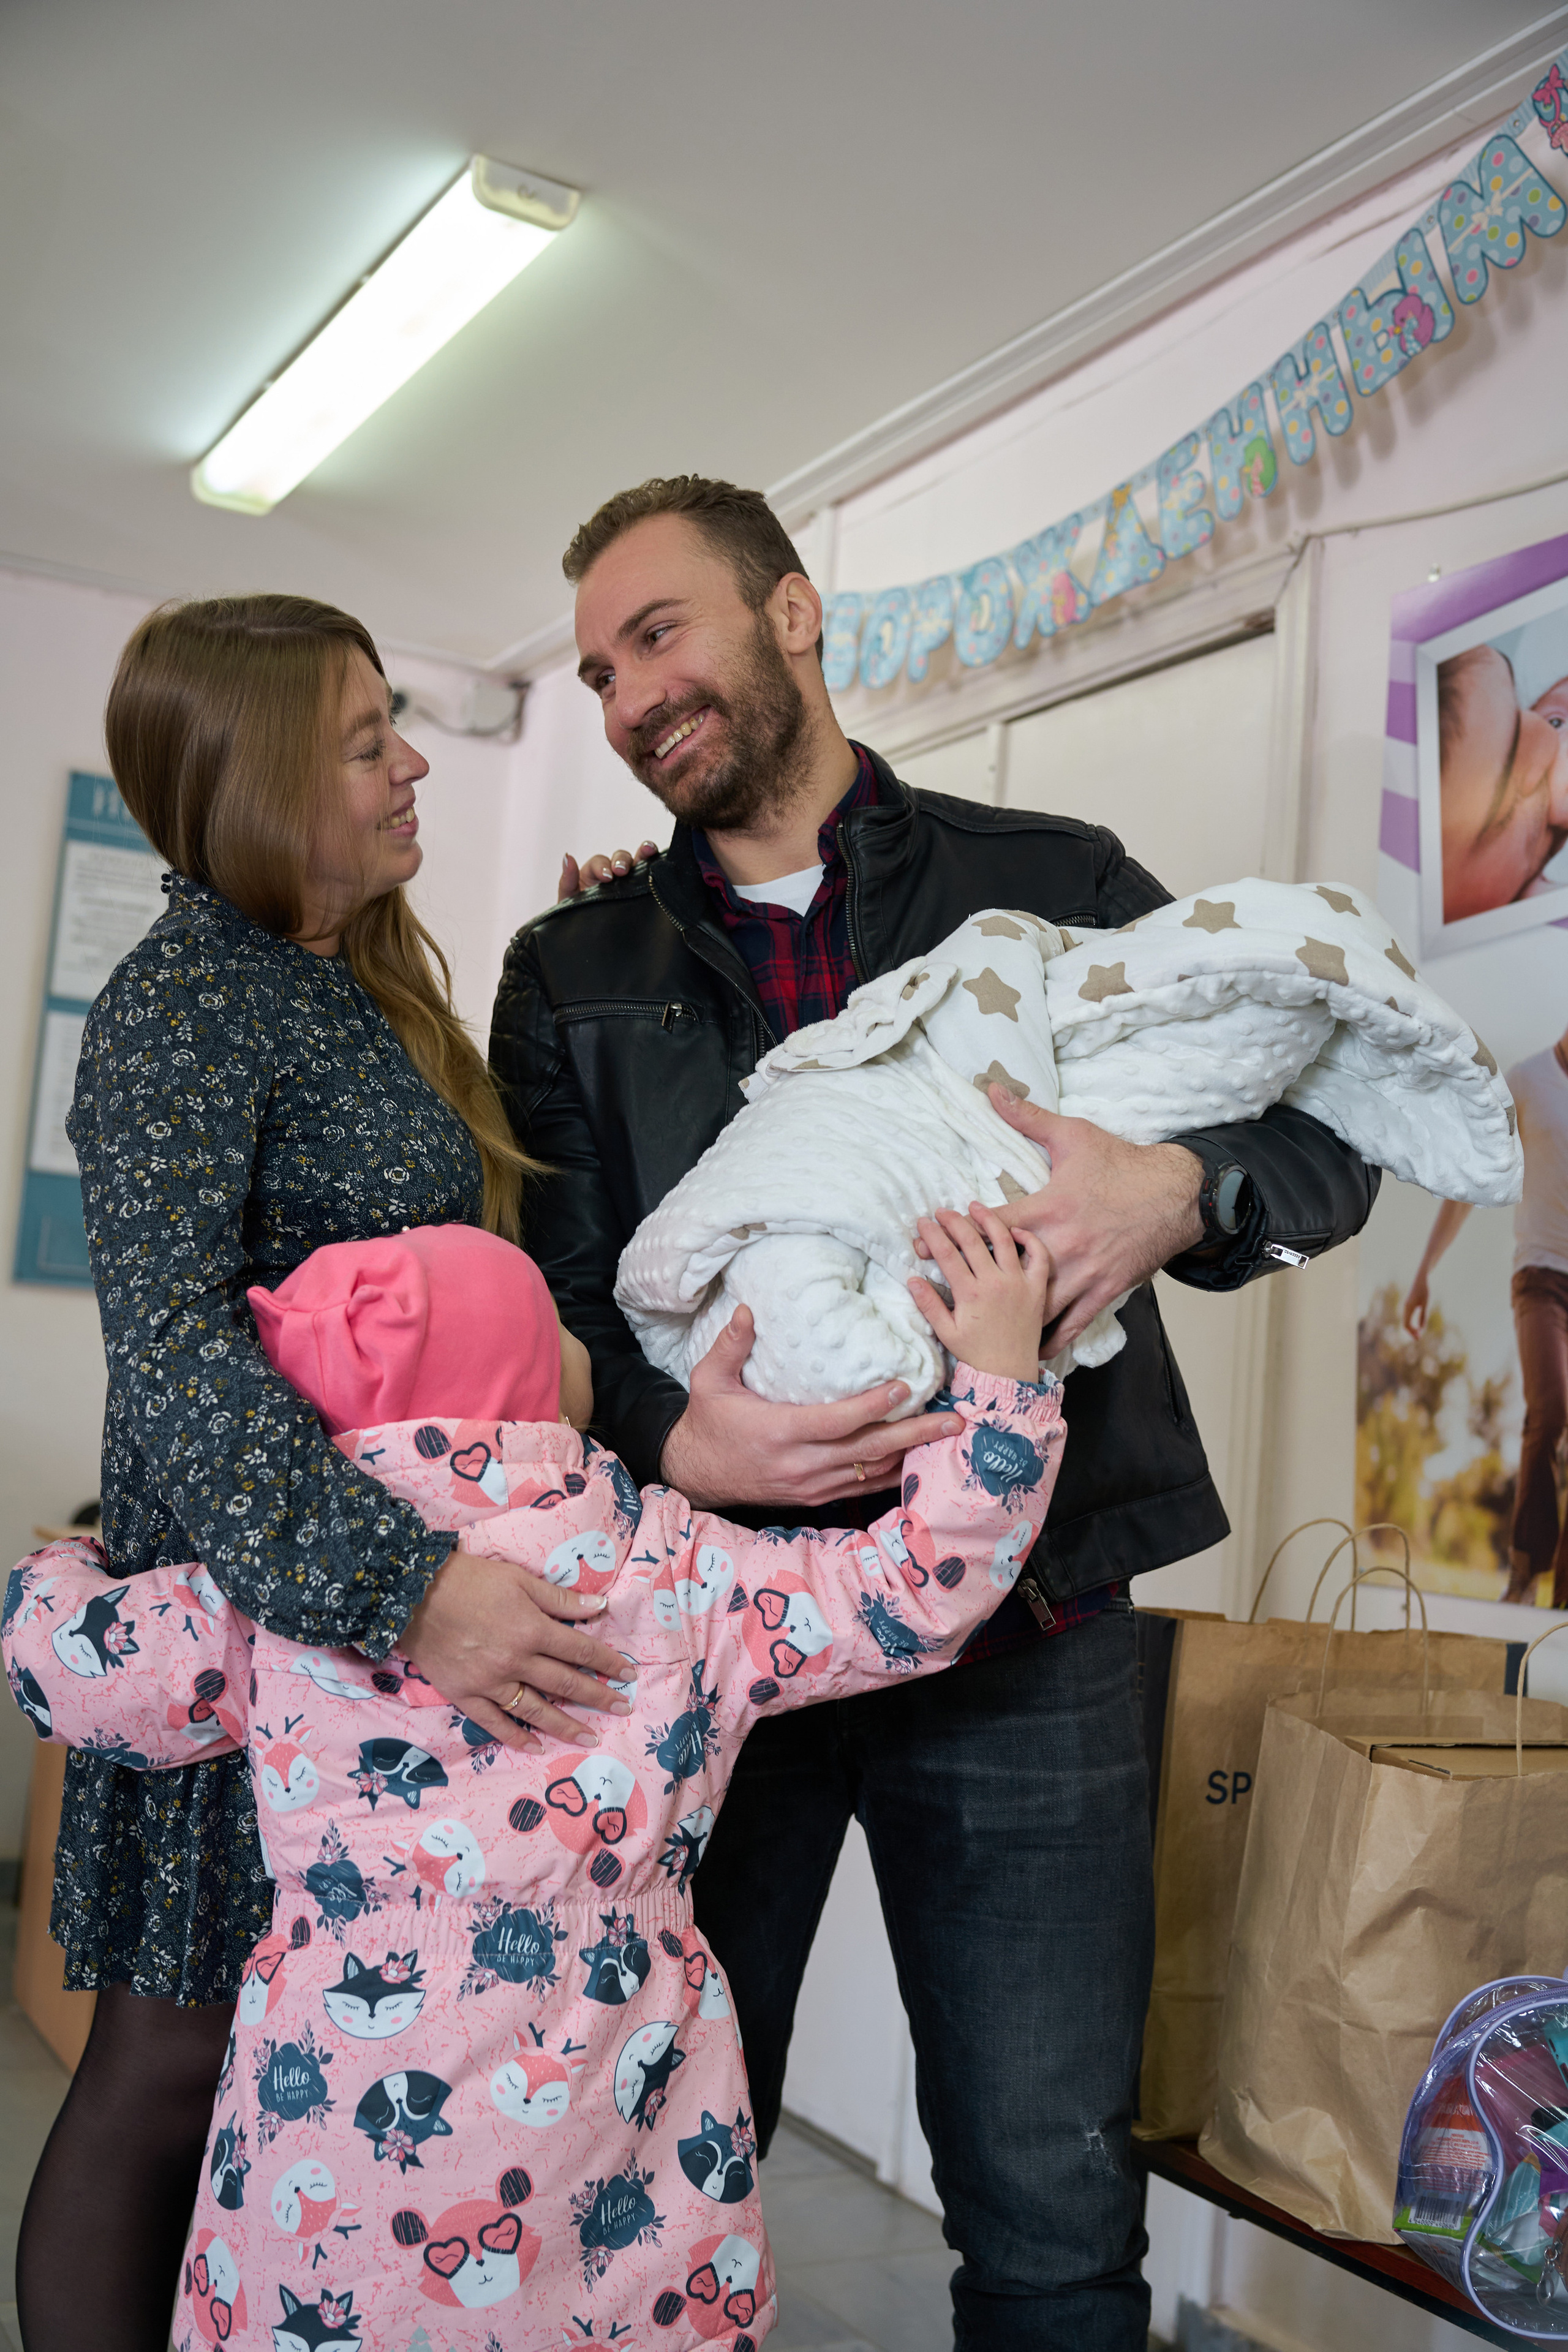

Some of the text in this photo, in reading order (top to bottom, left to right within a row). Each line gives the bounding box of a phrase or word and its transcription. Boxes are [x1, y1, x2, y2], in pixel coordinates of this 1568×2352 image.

[993, 1441, 1017, 1461] HAPPY
[983, 1451, 1023, 1483] Hello
[878, 1620, 899, 1641] HAPPY
[497, 1926, 540, 1954] Hello
[510, 1954, 535, 1967] HAPPY
[273, 2065, 311, 2093] Hello
[276, 2089, 309, 2103] BE HAPPY
[600, 2195, 637, 2226] Hello
[603, 2212, 635, 2236] BE HAPPY
